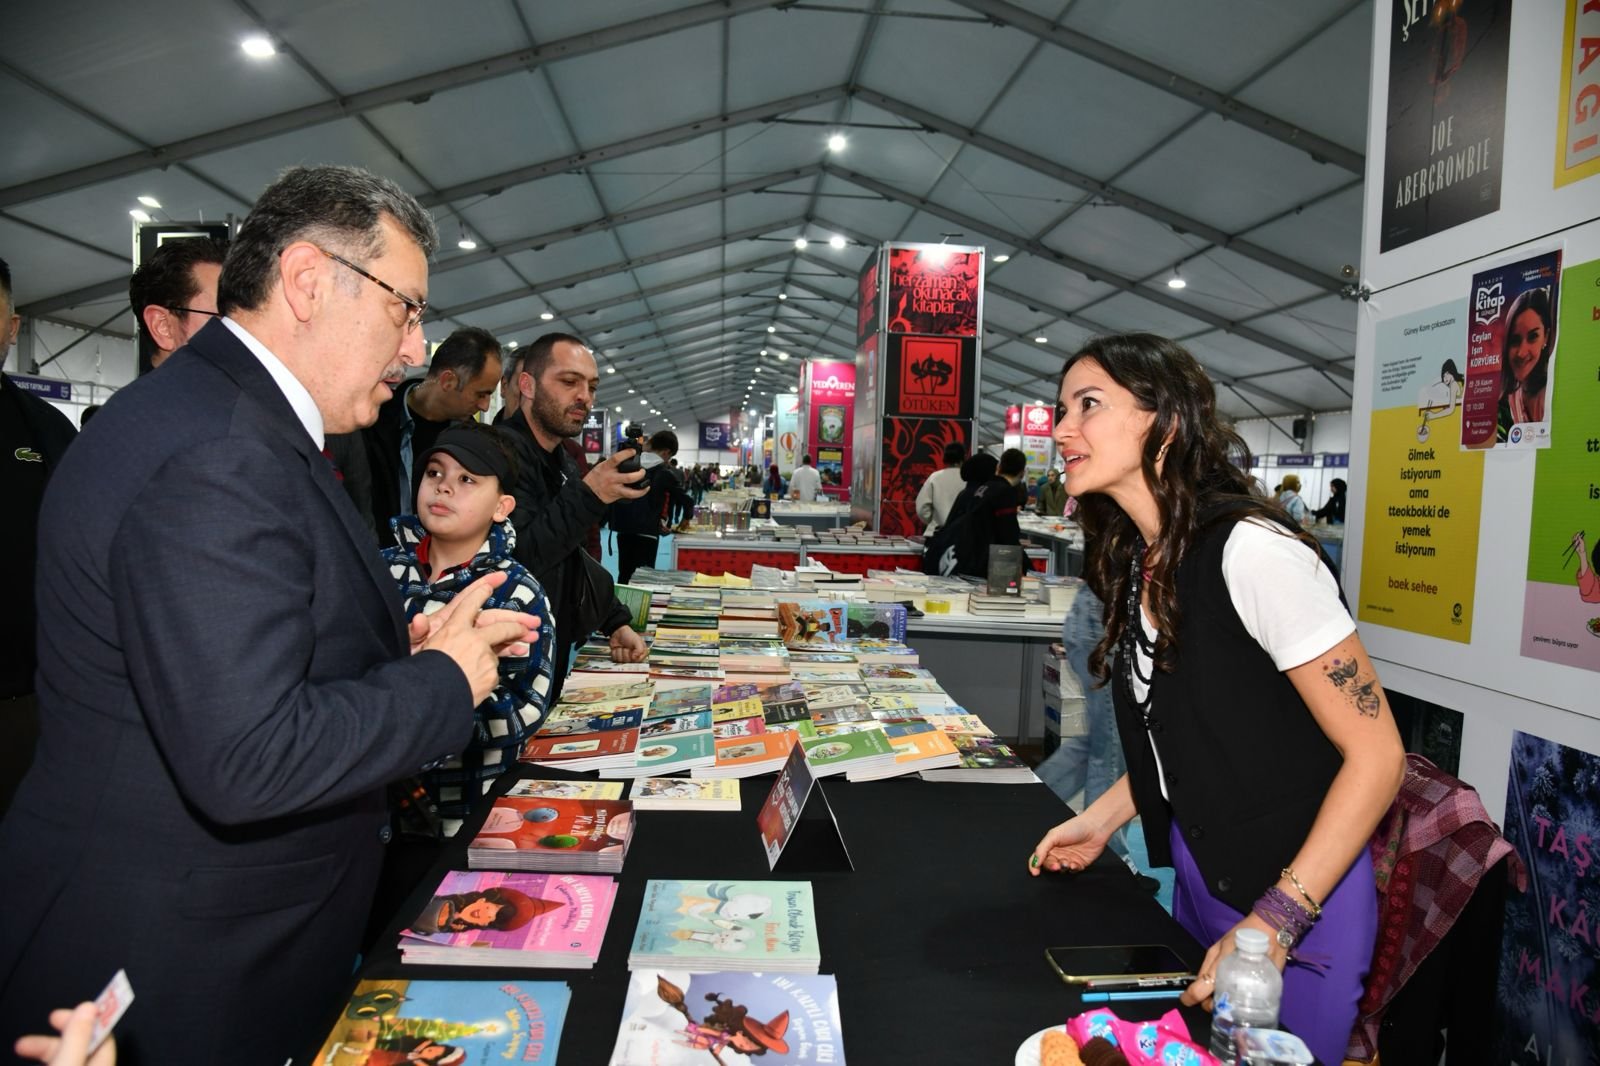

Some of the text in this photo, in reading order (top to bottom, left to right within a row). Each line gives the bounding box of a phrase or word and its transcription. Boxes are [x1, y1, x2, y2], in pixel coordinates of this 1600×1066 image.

[1430, 115, 1454, 156] JOE
[1395, 138, 1491, 209] ABERCROMBIE
[912, 286, 972, 303] okunacak
[1476, 295, 1505, 310] kitap
[1471, 332, 1492, 344] Ceylan
[1470, 354, 1500, 368] KORYÜREK
[902, 396, 956, 411] ÖTÜKEN
[1408, 448, 1435, 462] ölmek
[1400, 468, 1441, 483] istiyorum
[1409, 488, 1429, 499] ama
[1388, 505, 1450, 518] tteokbokki de
[1402, 525, 1431, 538] yemek
[1395, 541, 1436, 558] istiyorum
[1388, 576, 1438, 595] baek sehee
[1535, 816, 1592, 877] TAŞ
[1549, 894, 1600, 947] KÂ
